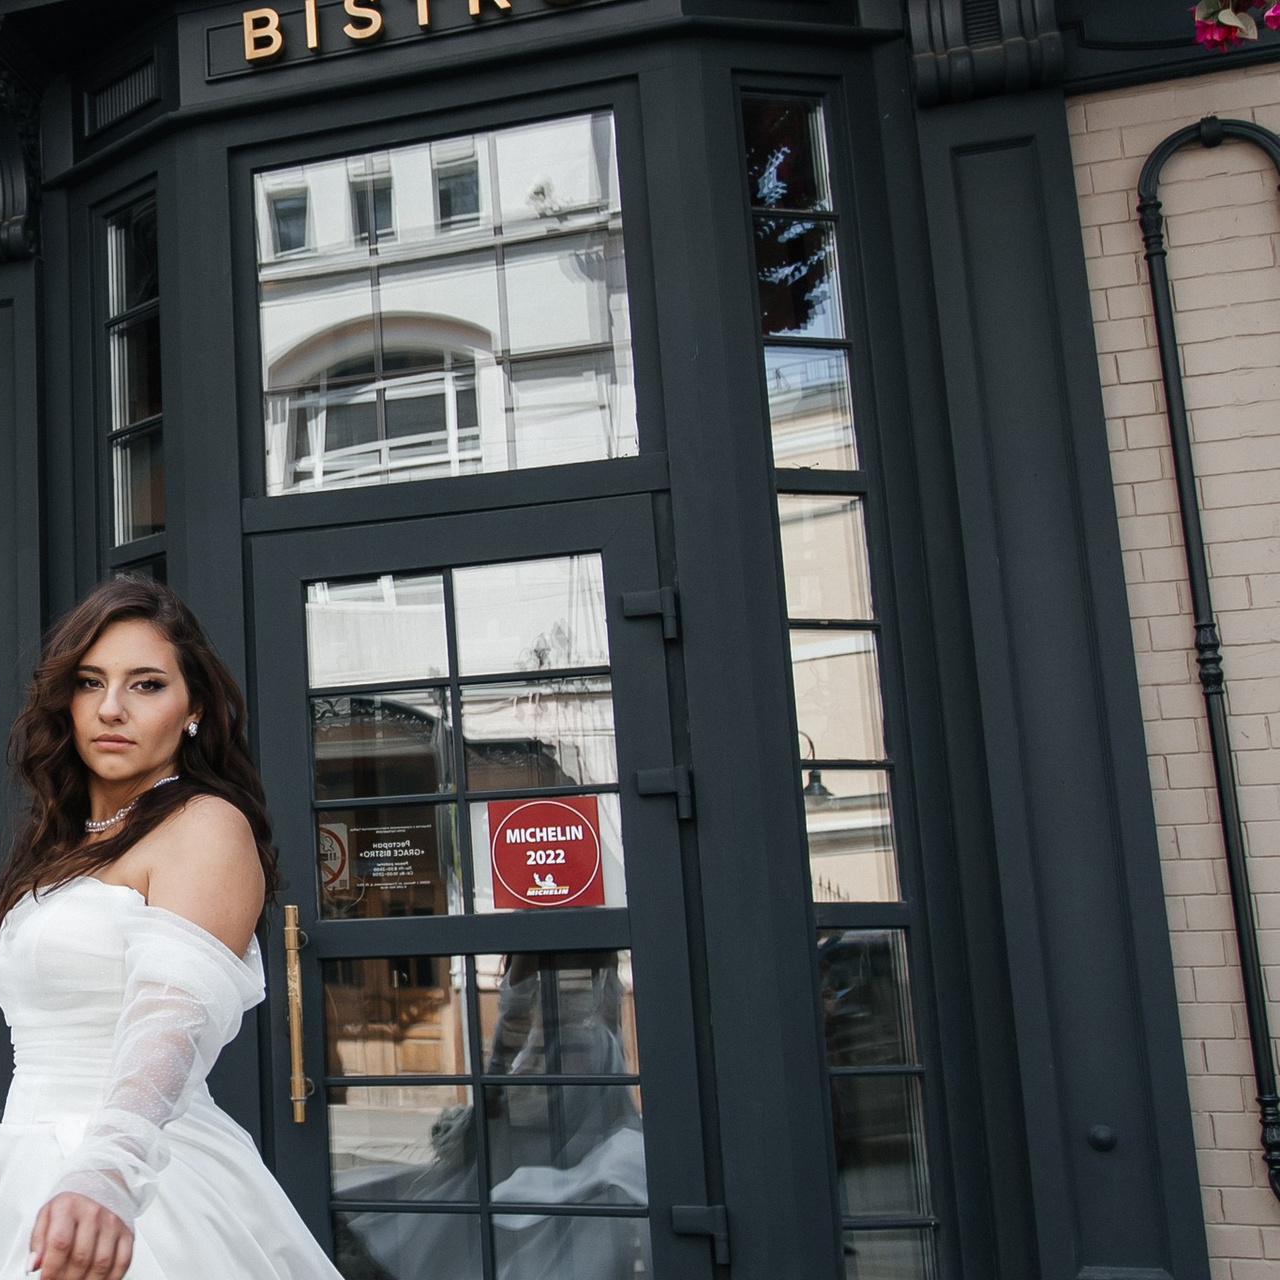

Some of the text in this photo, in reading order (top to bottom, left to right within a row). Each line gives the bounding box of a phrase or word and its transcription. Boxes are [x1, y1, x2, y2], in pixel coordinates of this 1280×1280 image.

[506, 825, 583, 844] MICHELIN
[526, 849, 566, 865] 2022
[526, 888, 569, 896] MICHELIN
